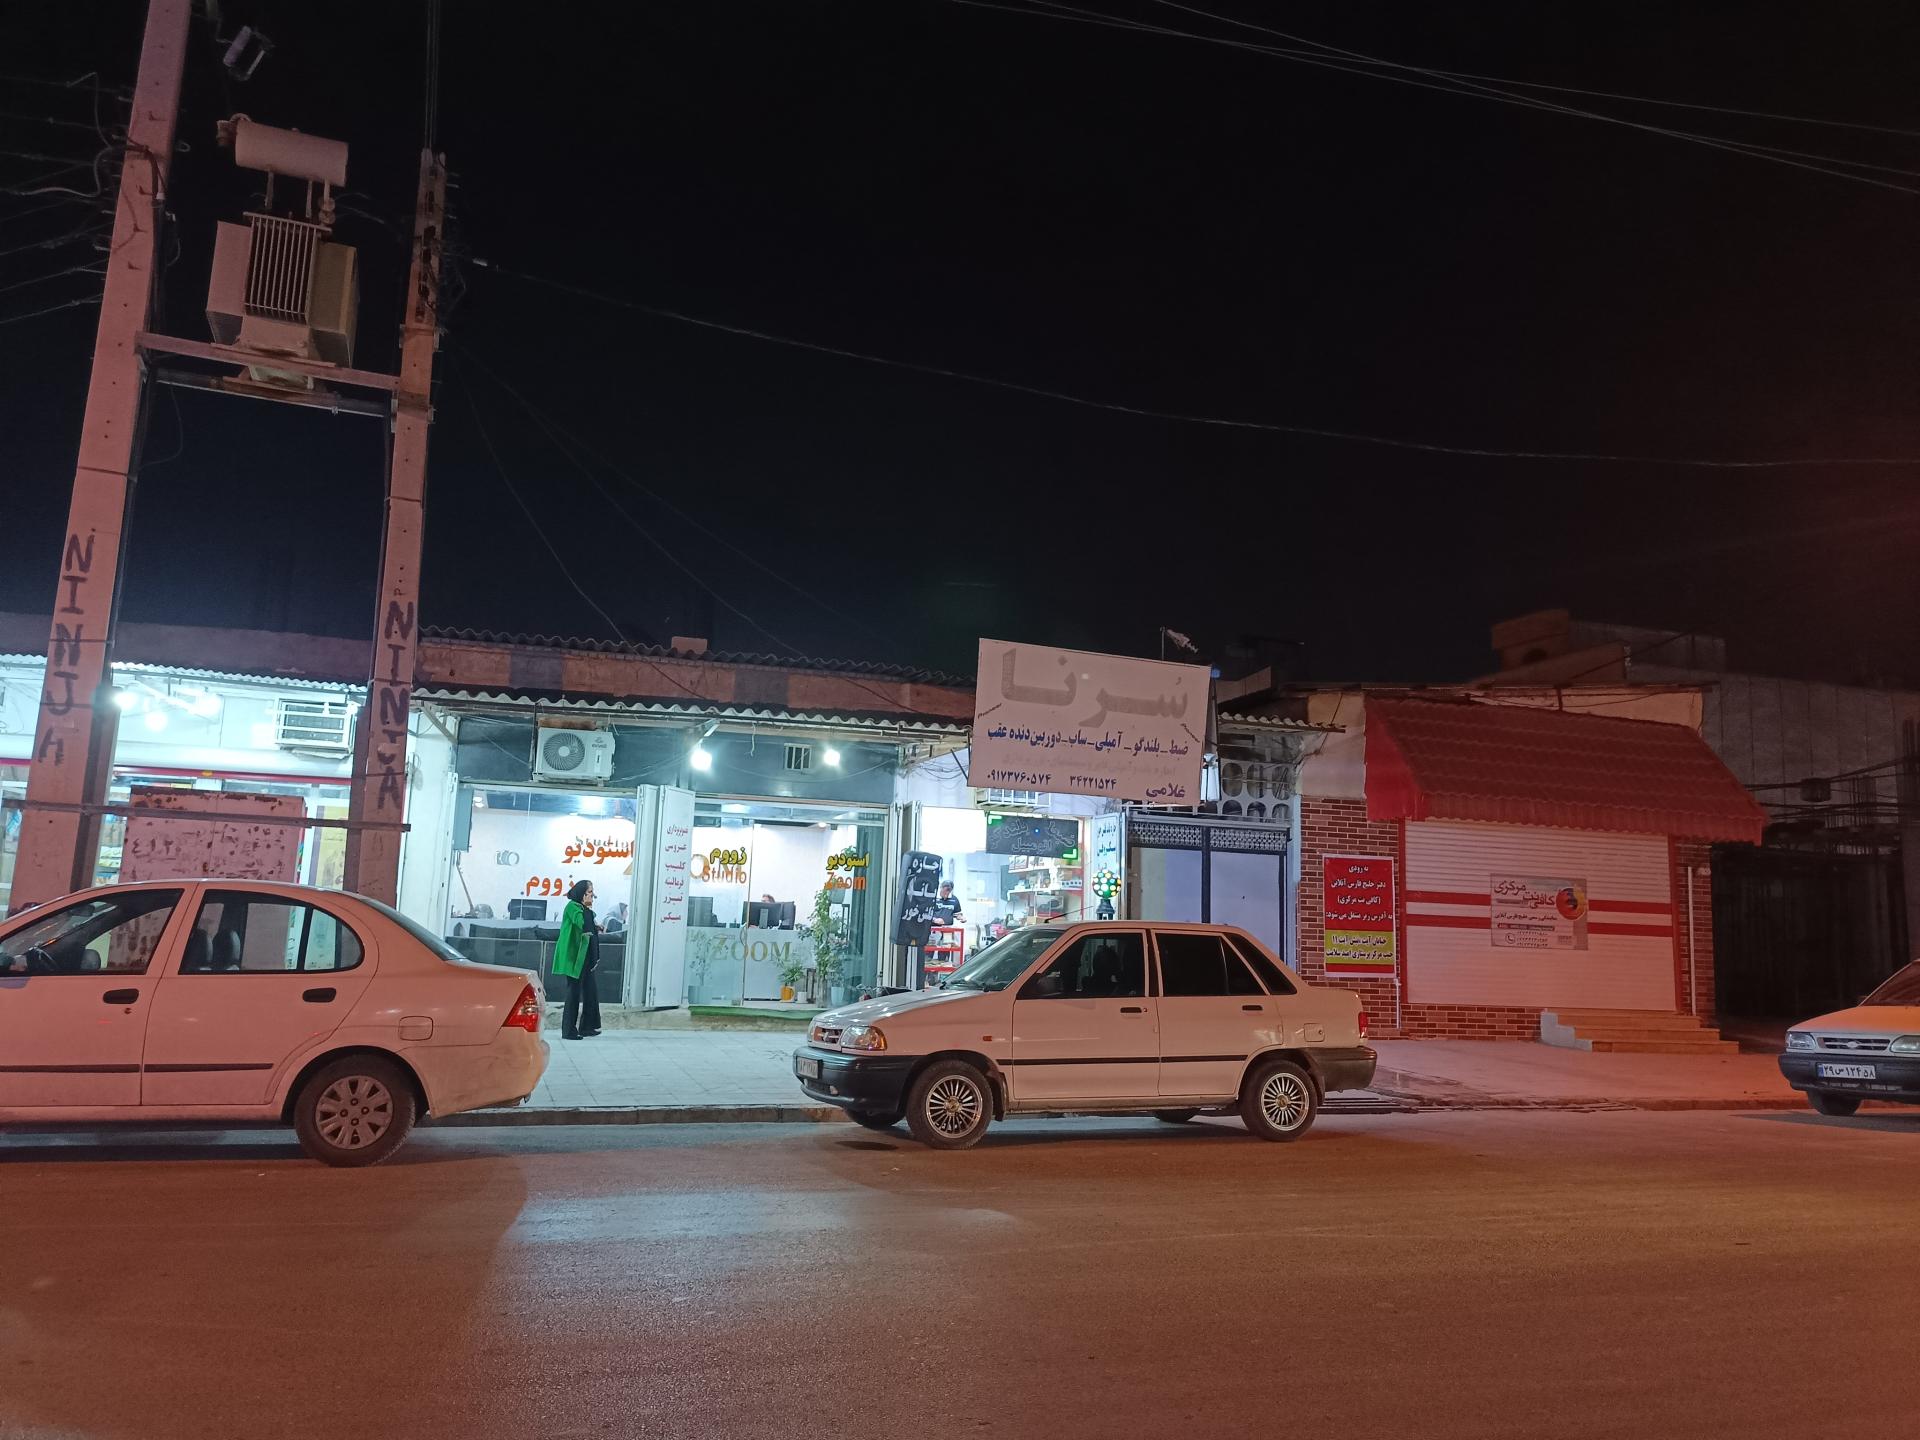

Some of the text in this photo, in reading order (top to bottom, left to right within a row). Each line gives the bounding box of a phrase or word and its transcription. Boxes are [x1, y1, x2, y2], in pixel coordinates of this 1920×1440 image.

[38, 533, 95, 766] NINJA
[1010, 725, 1031, 740] دنده
[1146, 782, 1186, 799] غلامی
[561, 840, 635, 864] استودیو
[709, 847, 748, 865] زووم
[826, 852, 870, 871] استودیو
[702, 866, 747, 884] Studio
[826, 872, 866, 890] Zoom
[1493, 880, 1526, 896] مرکزی
[1529, 894, 1556, 909] کافی
[711, 935, 792, 962] ZOOM
